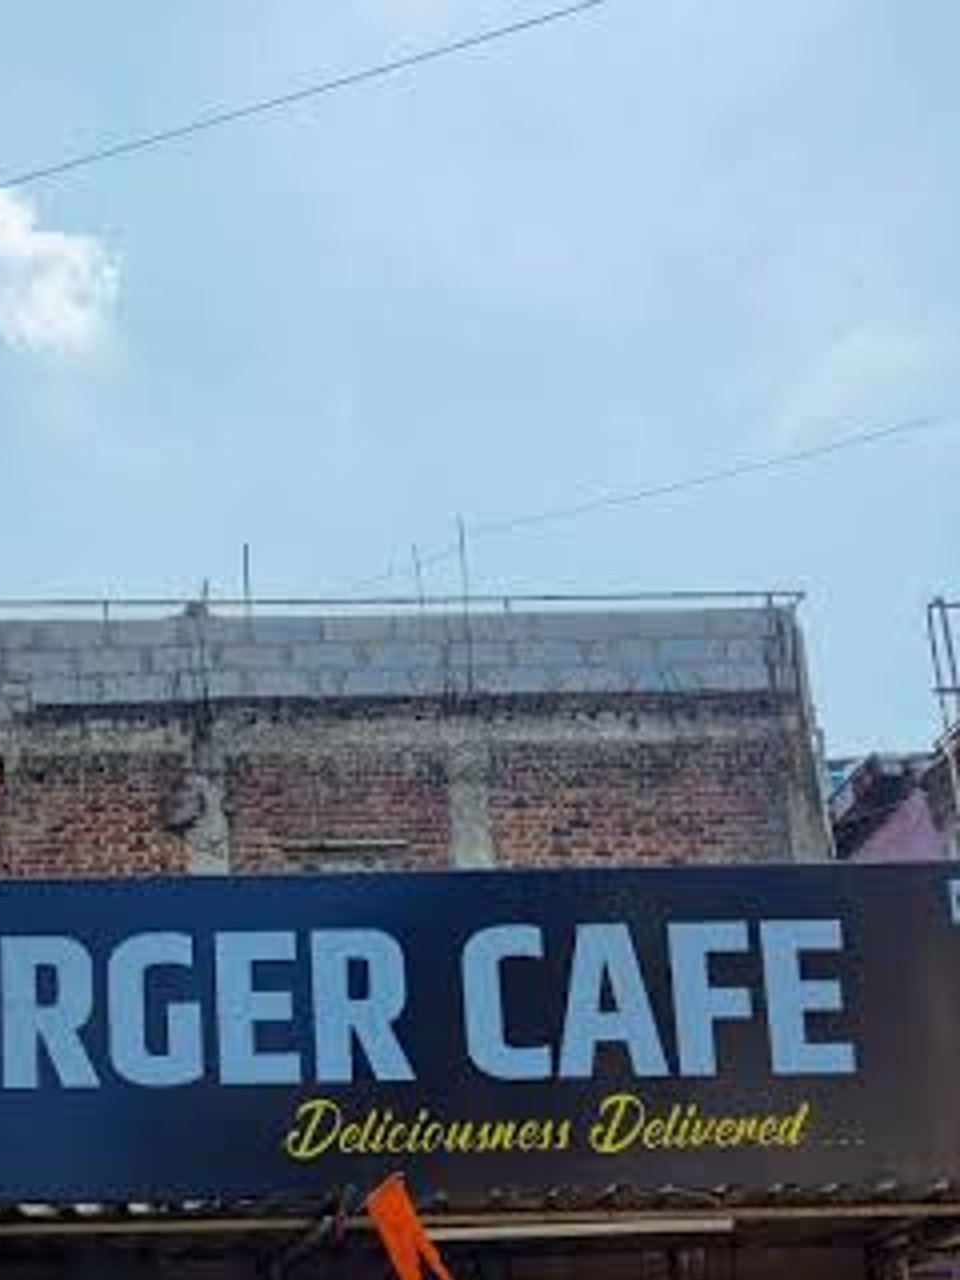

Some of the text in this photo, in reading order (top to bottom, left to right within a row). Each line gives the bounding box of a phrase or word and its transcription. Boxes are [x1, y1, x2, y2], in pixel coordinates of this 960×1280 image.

[461, 919, 857, 1081] CAFE
[285, 1098, 570, 1159] Deliciousness
[589, 1094, 810, 1154] Delivered
